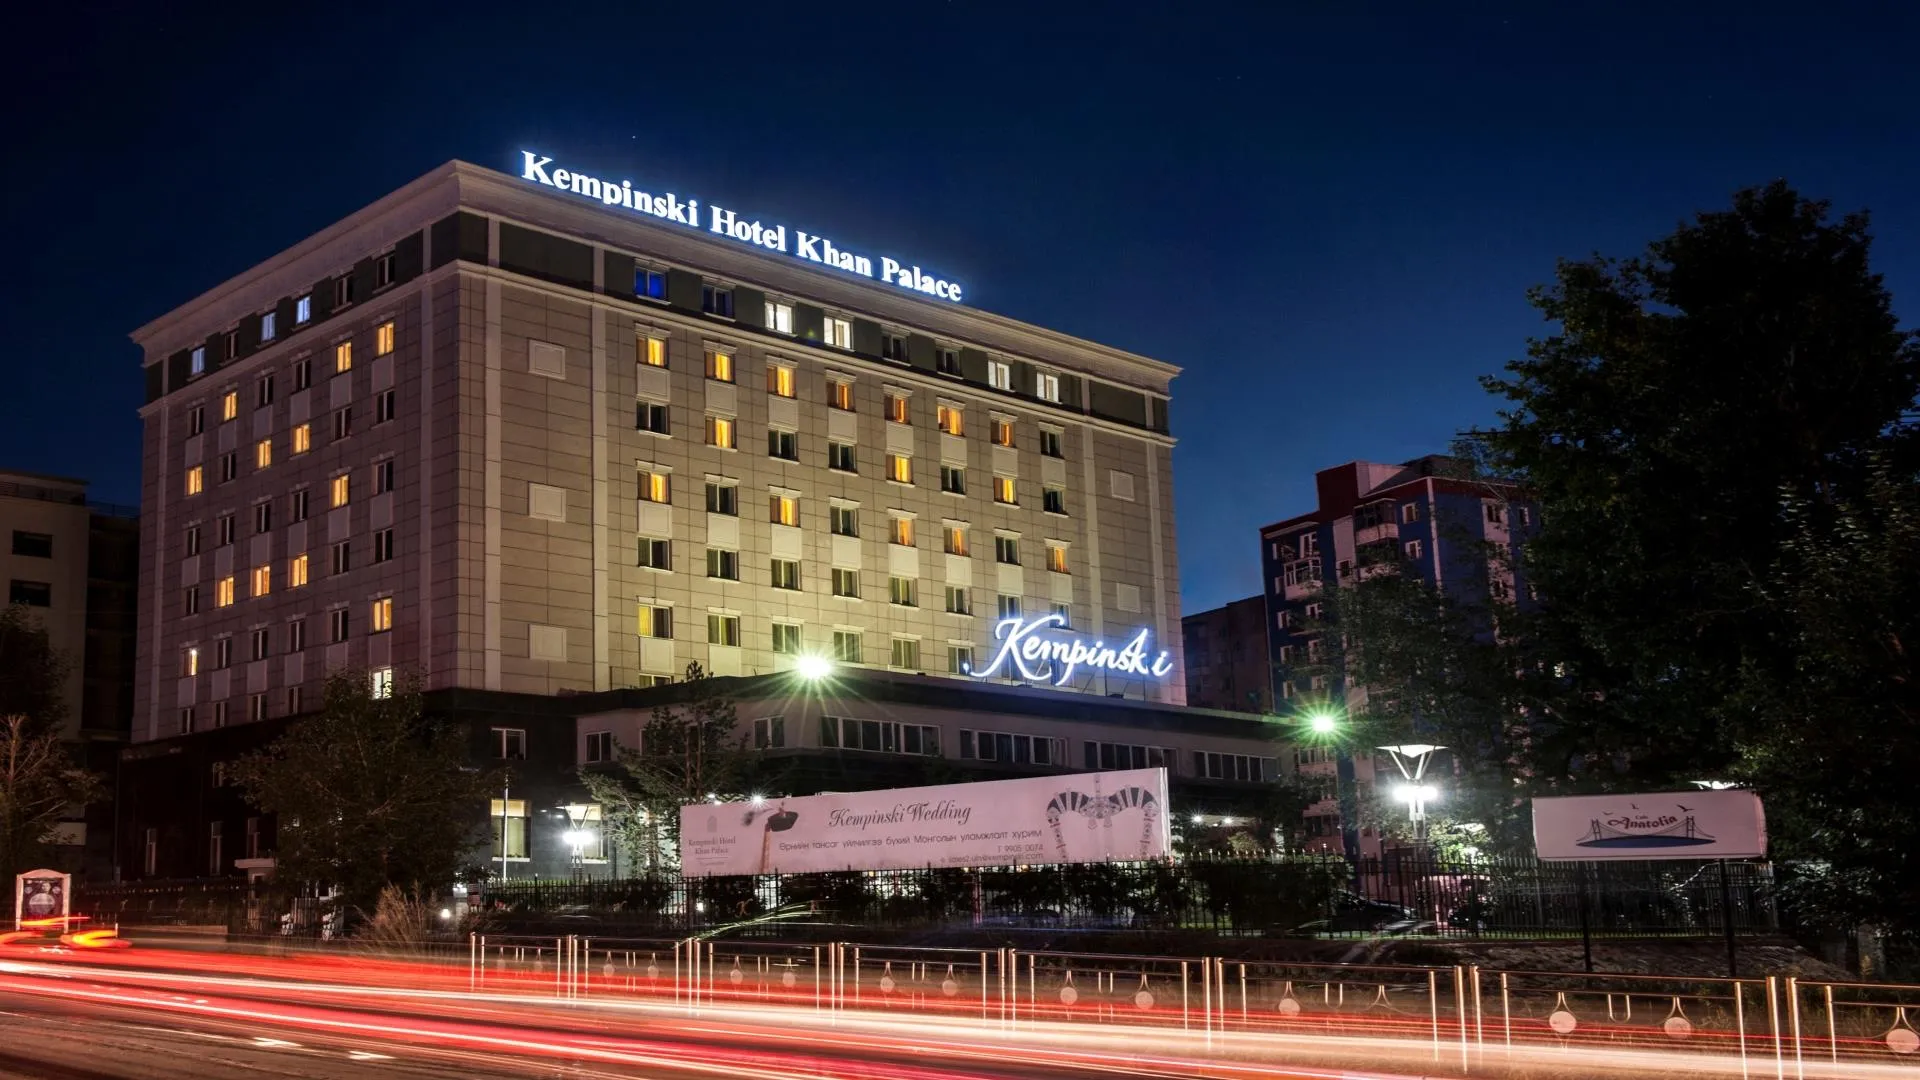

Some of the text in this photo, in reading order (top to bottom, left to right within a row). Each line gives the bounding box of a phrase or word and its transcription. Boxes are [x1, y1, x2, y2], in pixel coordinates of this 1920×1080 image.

[521, 150, 963, 302] Kempinski Hotel Khan Palace
[963, 614, 1174, 686] Kempinski
[828, 799, 972, 831] Kempinski Wedding
[1607, 816, 1677, 829] Anatolia
[914, 834, 956, 844] Монголын
[960, 831, 1008, 843] уламжлалт
[1012, 829, 1042, 840] хурим
